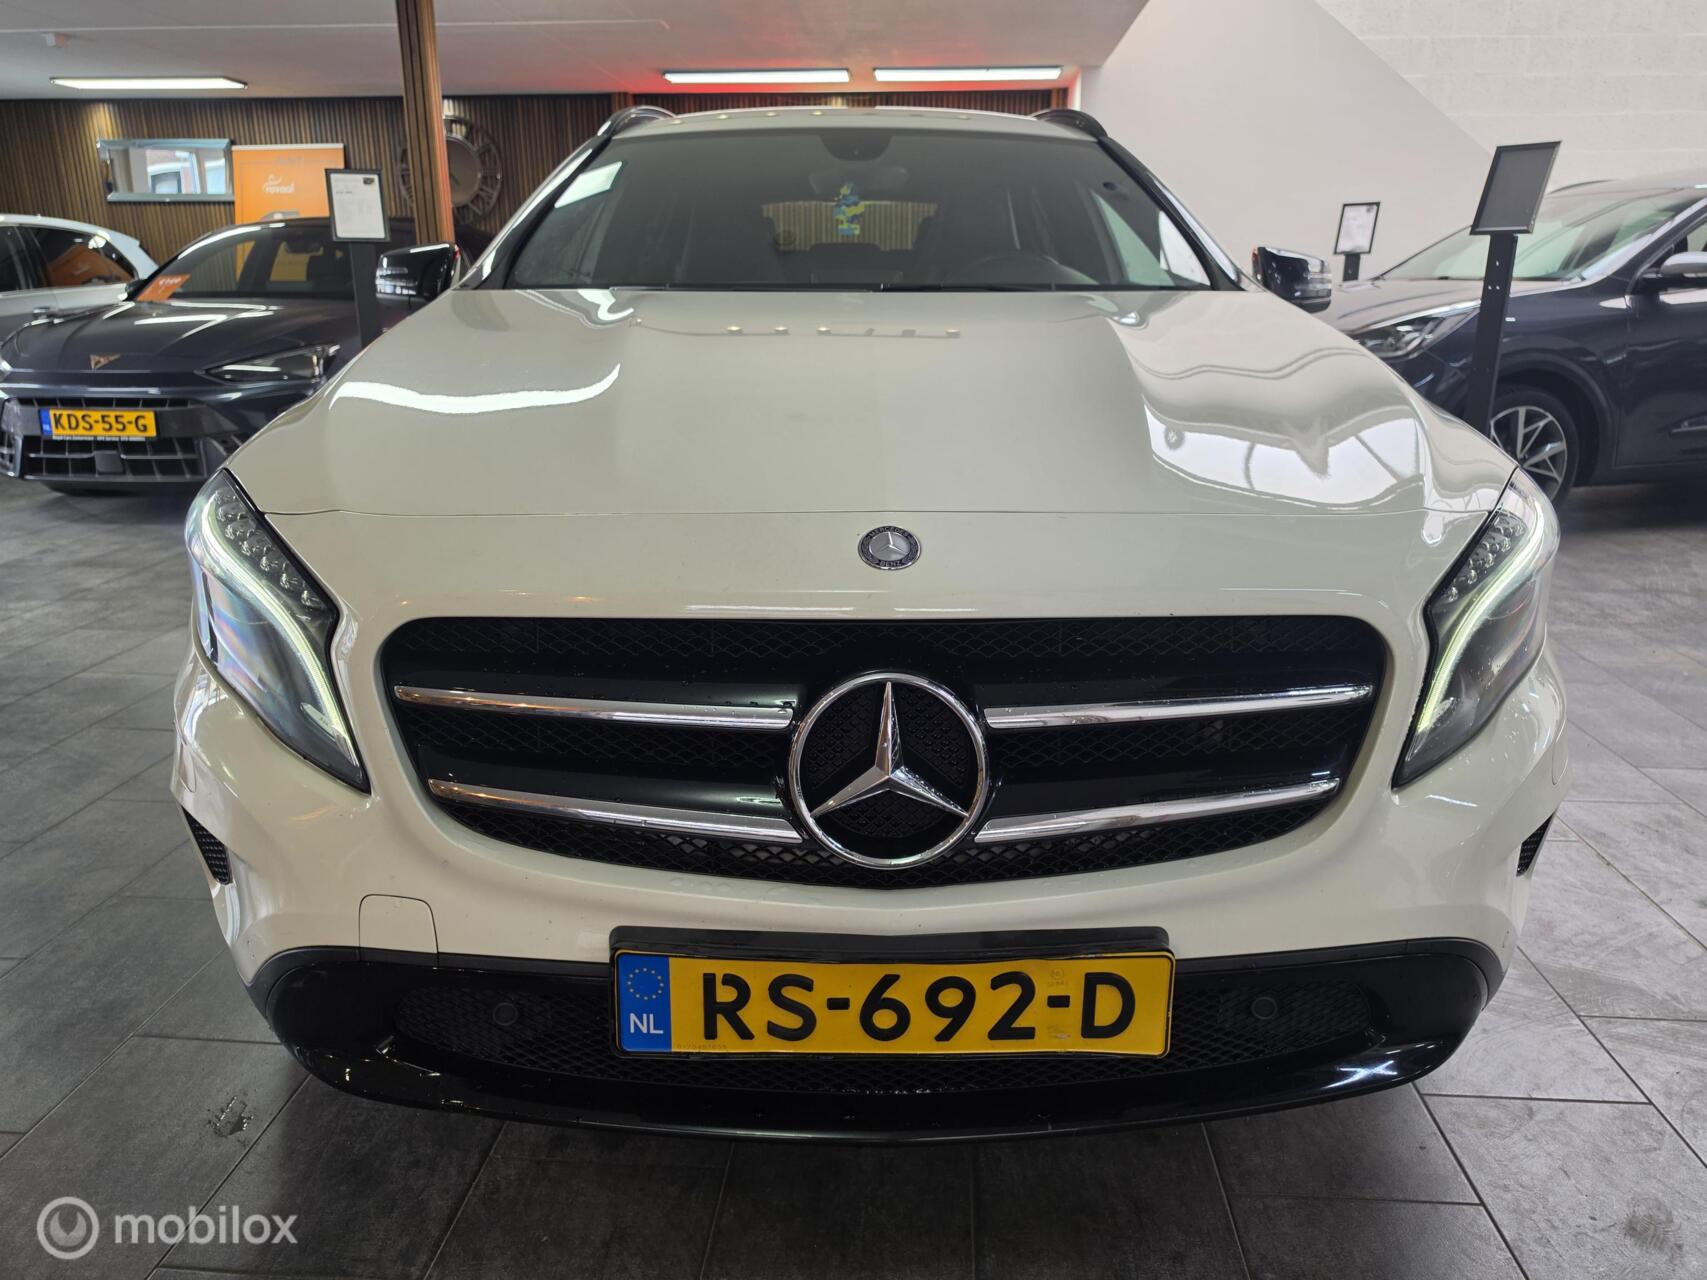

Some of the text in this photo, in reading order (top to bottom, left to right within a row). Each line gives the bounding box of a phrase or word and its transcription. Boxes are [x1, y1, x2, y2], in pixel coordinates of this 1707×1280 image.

[53, 413, 148, 433] KDS-55-G
[702, 971, 1136, 1042] RS-692-D
[629, 1013, 664, 1034] NL
